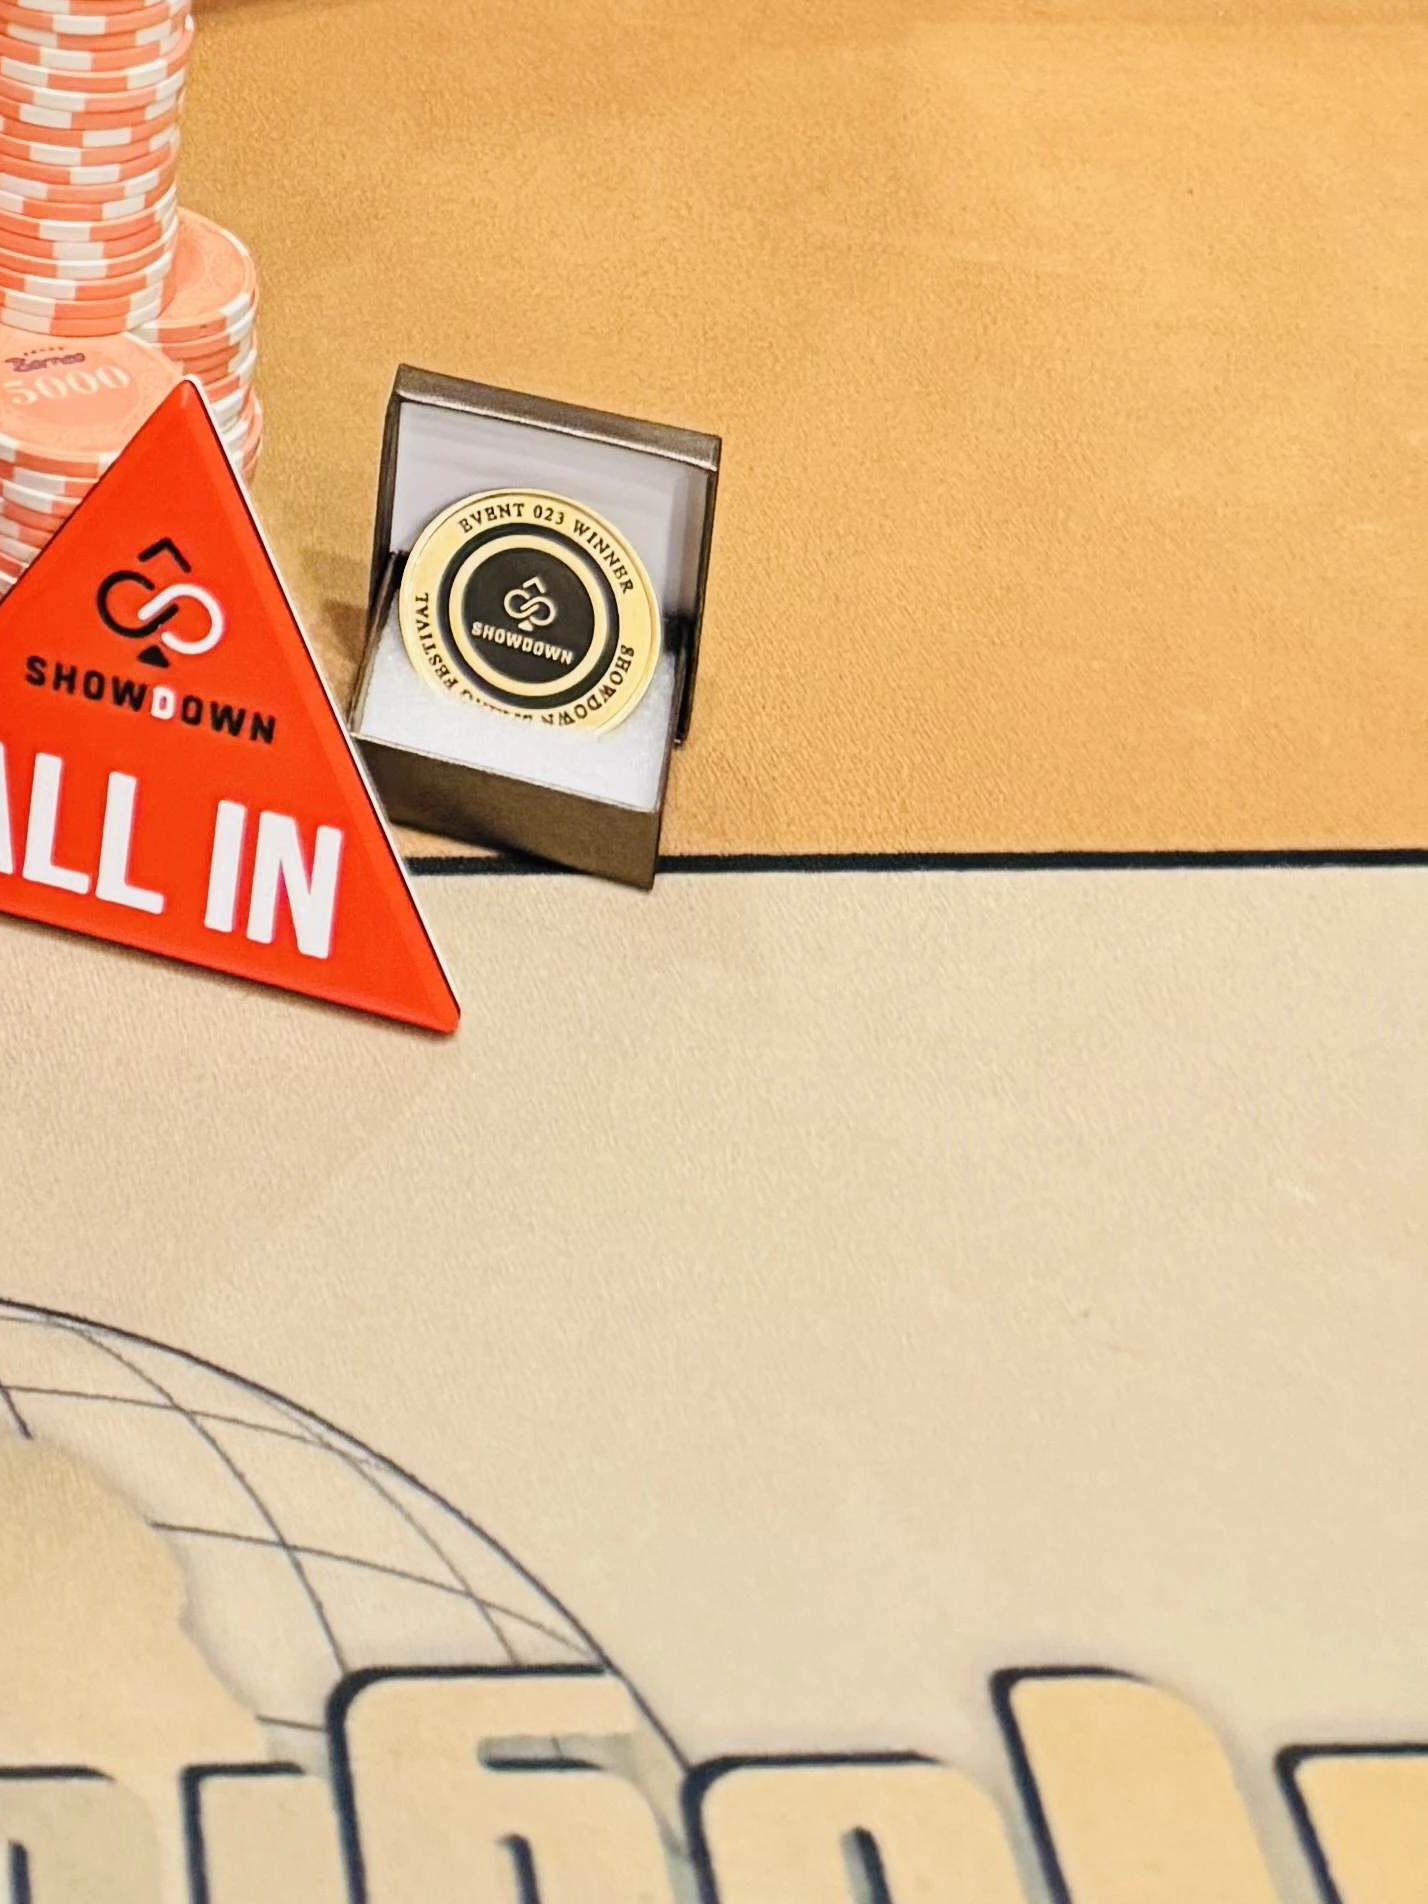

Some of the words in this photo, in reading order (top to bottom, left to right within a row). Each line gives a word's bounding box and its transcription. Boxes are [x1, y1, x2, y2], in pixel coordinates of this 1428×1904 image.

[3, 365, 130, 405] 5000
[457, 503, 524, 534] EVENT
[533, 504, 565, 526] 023
[572, 519, 634, 595] WINNER
[415, 592, 458, 692] FESTIVAL
[471, 622, 574, 665] SHOWDOWN
[25, 655, 277, 745] SHOWDOWN
[204, 800, 343, 960] IN
